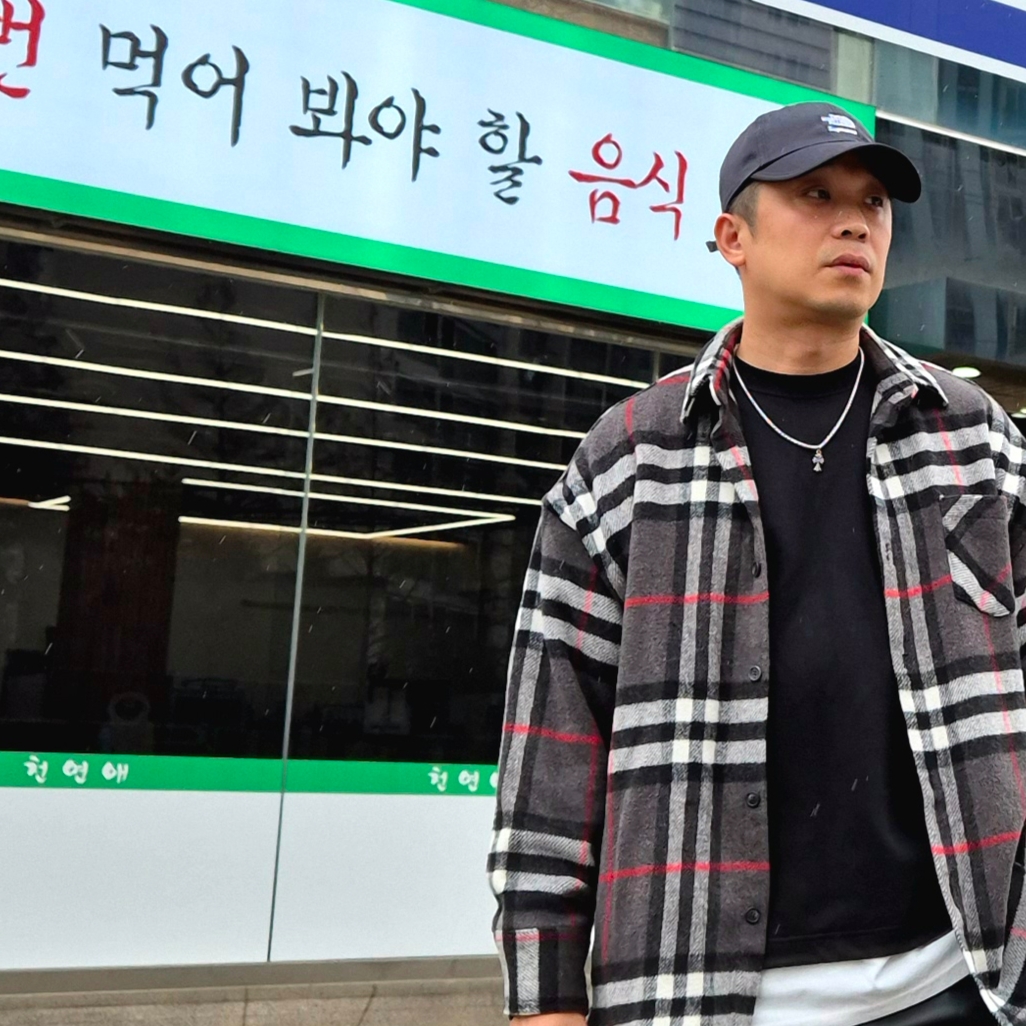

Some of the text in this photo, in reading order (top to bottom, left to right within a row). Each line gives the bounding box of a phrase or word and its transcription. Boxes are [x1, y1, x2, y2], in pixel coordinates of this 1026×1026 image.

[100, 24, 249, 147] 먹어
[291, 70, 441, 182] 봐야
[478, 109, 542, 204] 할
[569, 133, 688, 241] 음식
